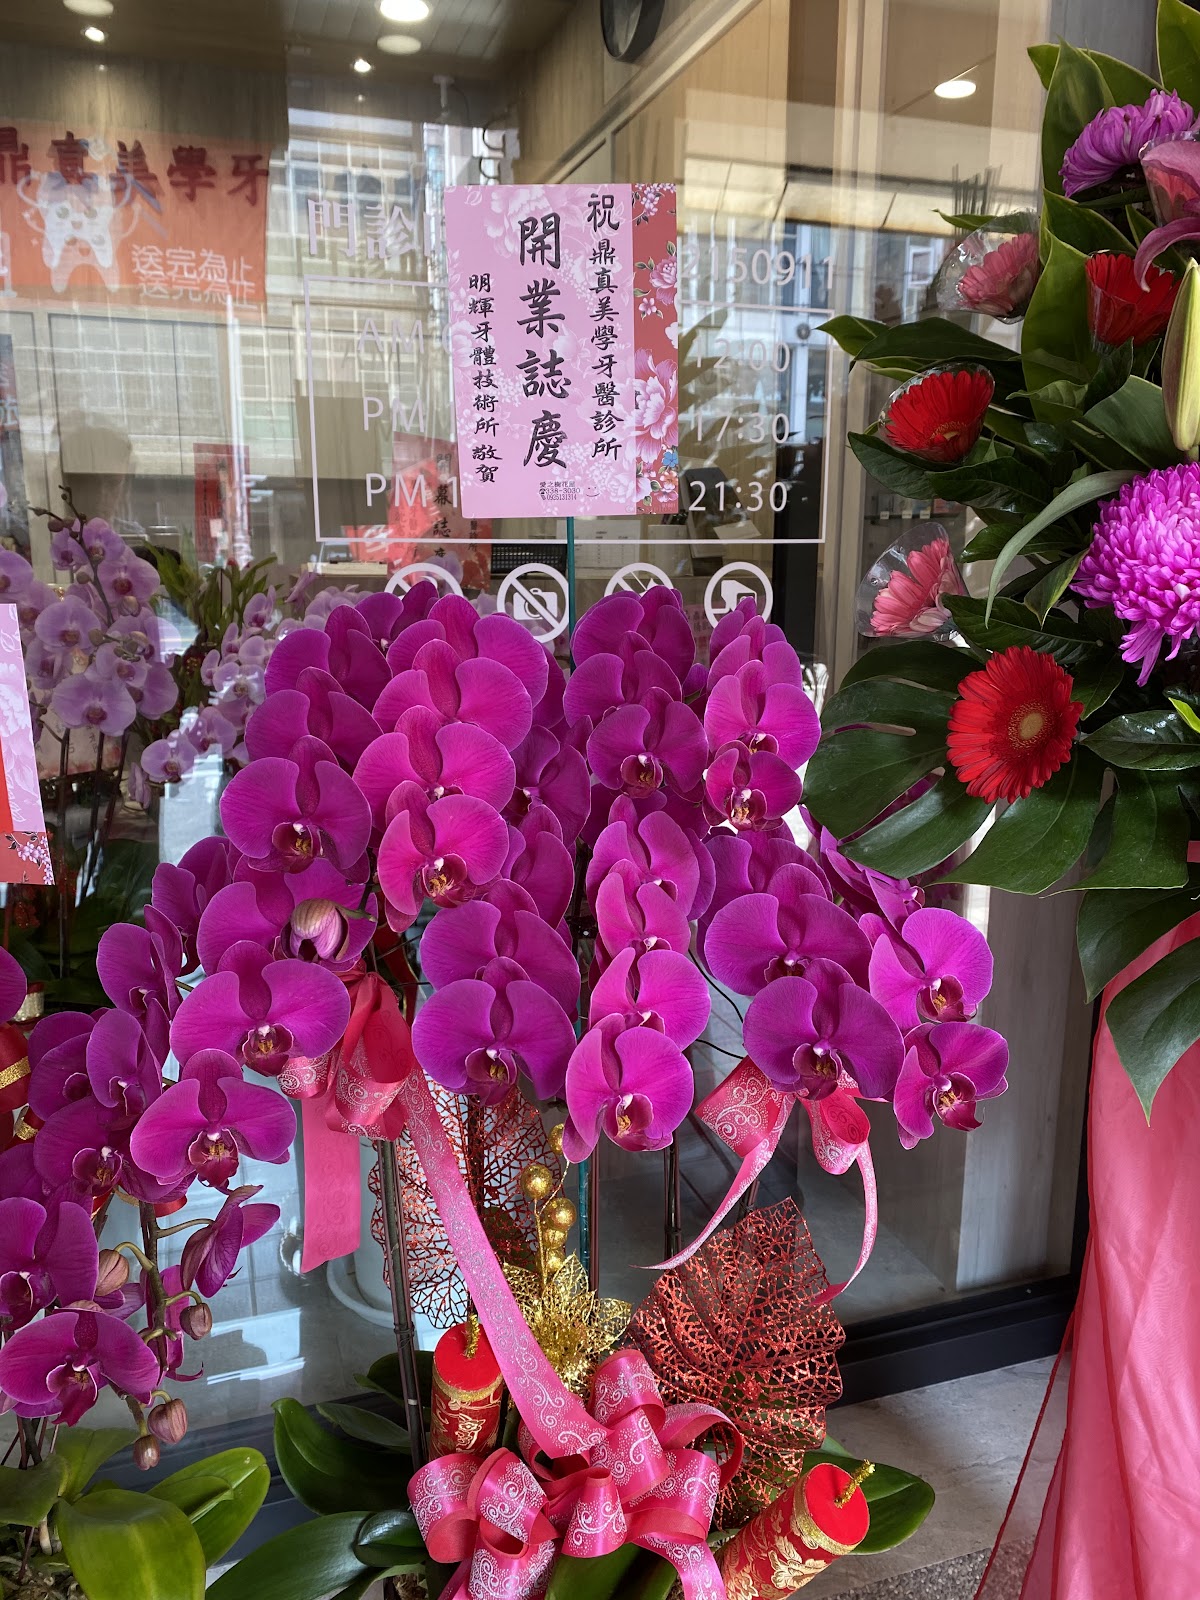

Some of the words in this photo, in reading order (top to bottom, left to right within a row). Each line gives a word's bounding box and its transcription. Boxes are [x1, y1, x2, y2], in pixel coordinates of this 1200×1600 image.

[131, 243, 255, 289] 送完為止
[358, 317, 425, 354] AM
[515, 212, 571, 469] 開業誌慶
[694, 338, 791, 373] 12:00
[362, 396, 426, 433] PM
[694, 411, 790, 445] 17:30
[365, 472, 427, 508] PM
[688, 480, 788, 512] 21:30
